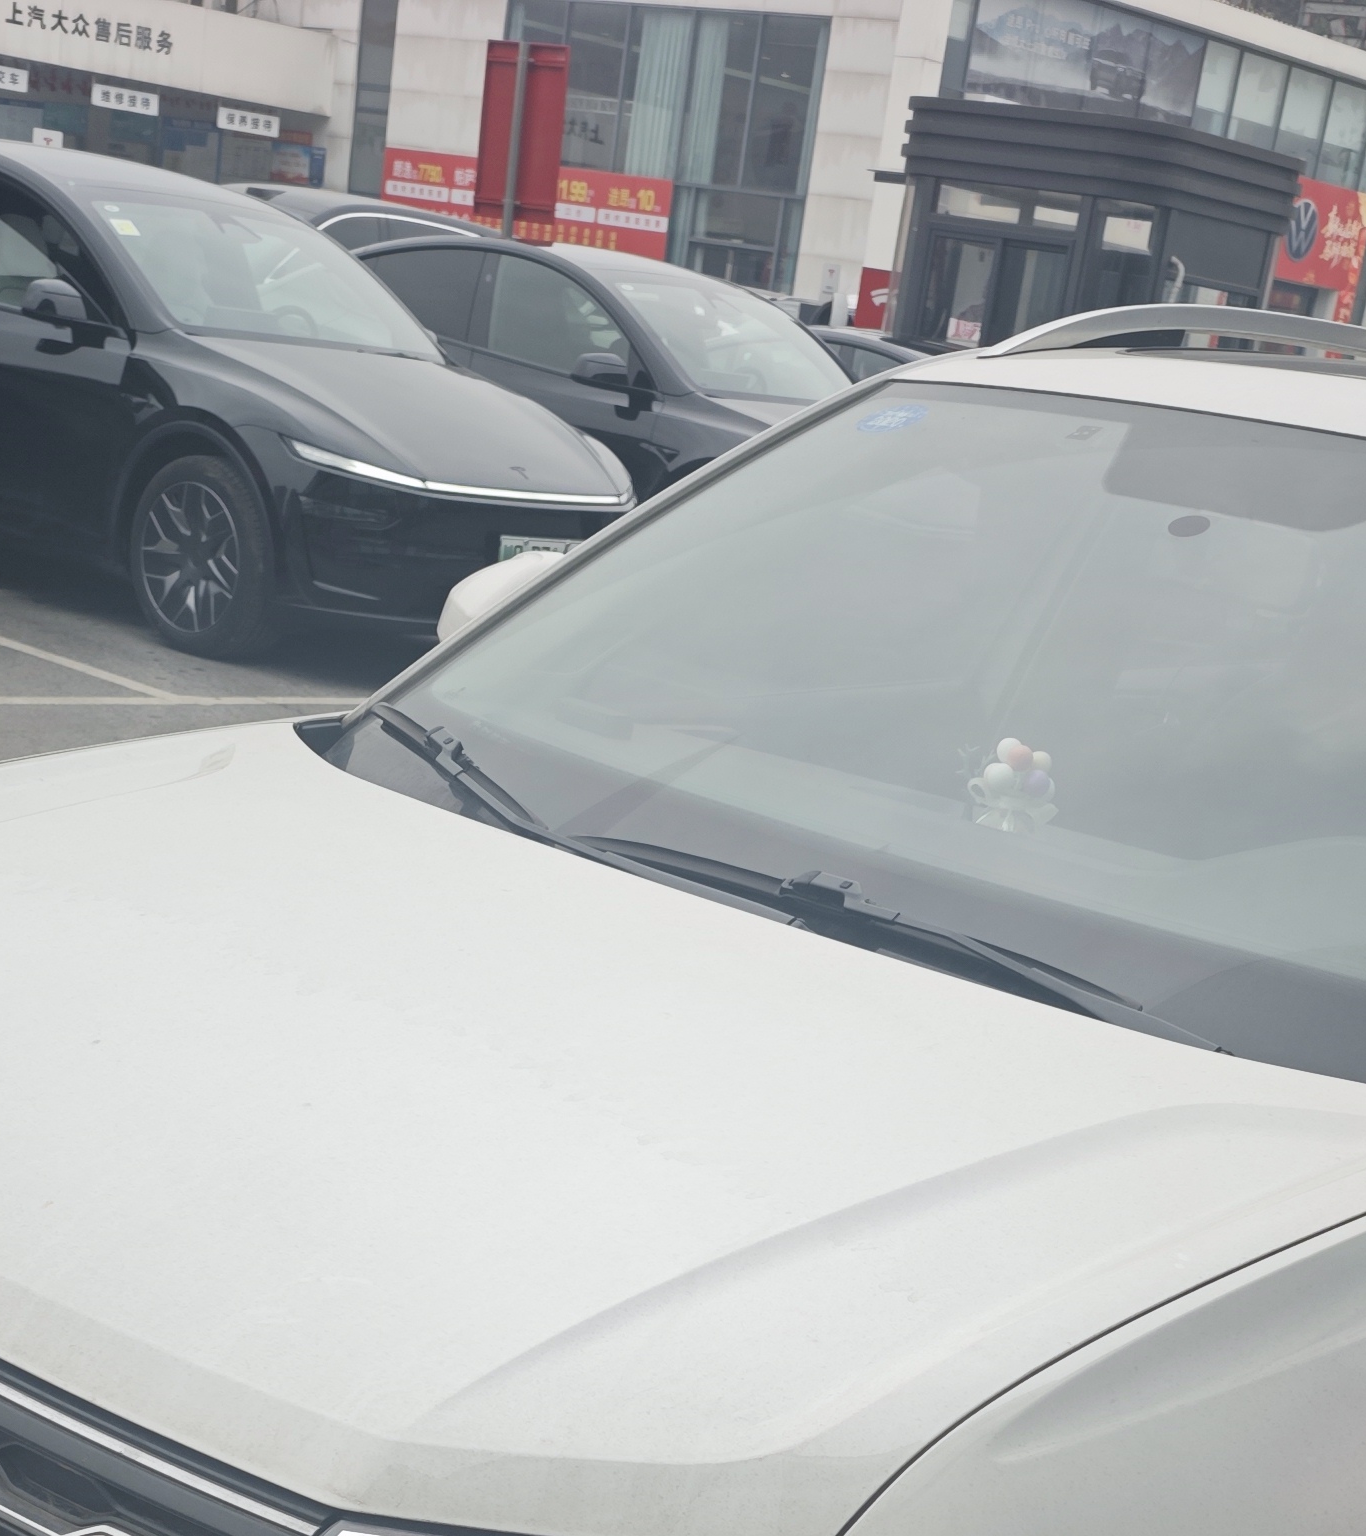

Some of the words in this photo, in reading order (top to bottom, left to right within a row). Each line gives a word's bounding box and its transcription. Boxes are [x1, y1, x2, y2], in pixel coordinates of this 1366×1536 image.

[5, 1, 173, 55] 上汽大众售后服务
